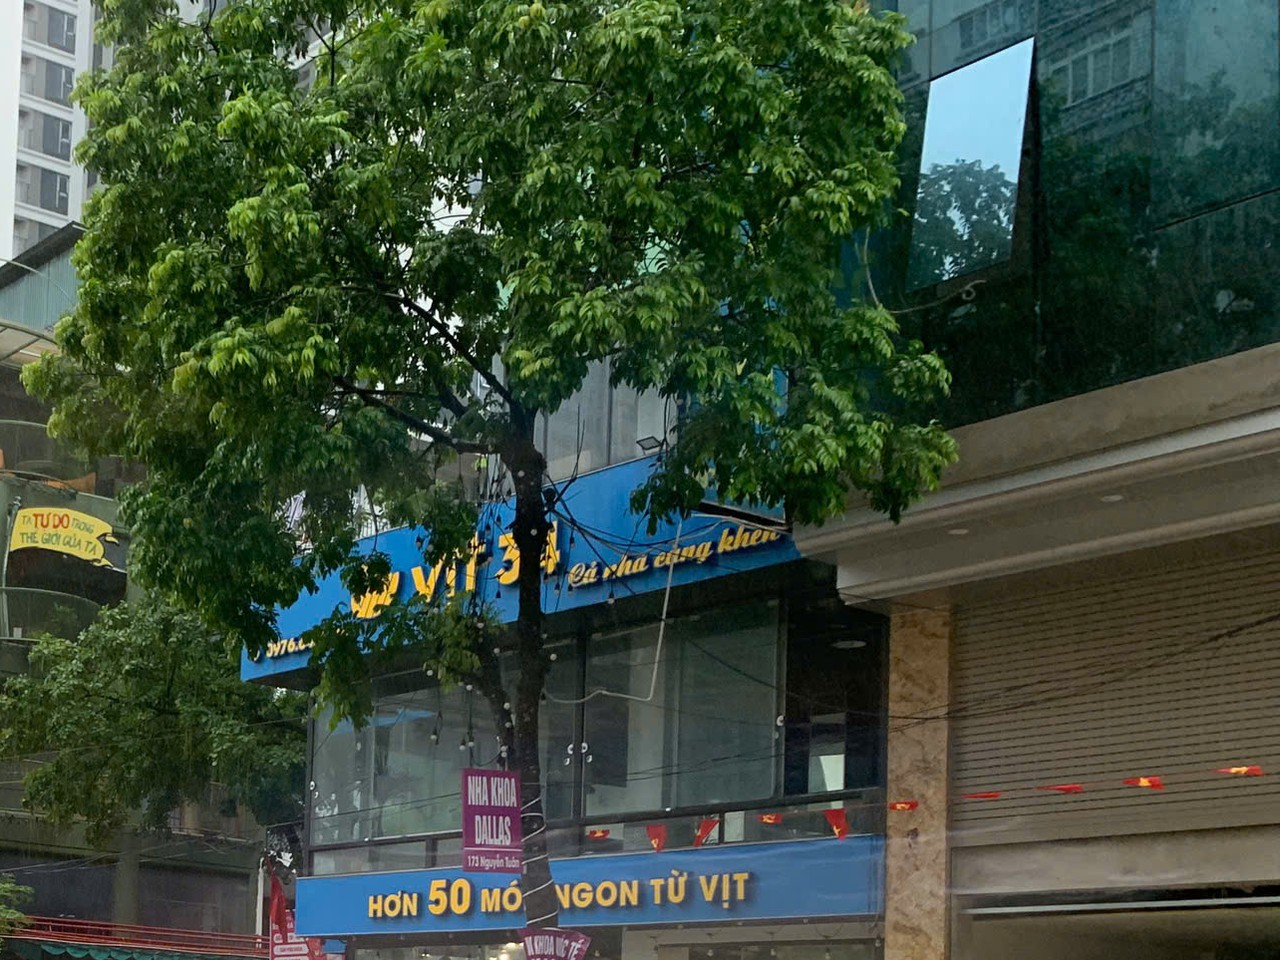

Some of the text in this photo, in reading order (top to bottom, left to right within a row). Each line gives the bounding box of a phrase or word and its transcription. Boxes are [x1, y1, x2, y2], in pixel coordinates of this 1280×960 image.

[21, 515, 32, 525] TA
[52, 513, 70, 529] DO
[84, 541, 97, 555] TA
[468, 775, 518, 808] NHA KHOA
[475, 814, 511, 846] DALLAS
[468, 855, 479, 867] 173
[368, 869, 749, 918] HƠN 50 MÓ NGON TỪ VỊT
[534, 935, 554, 956] KHOA
